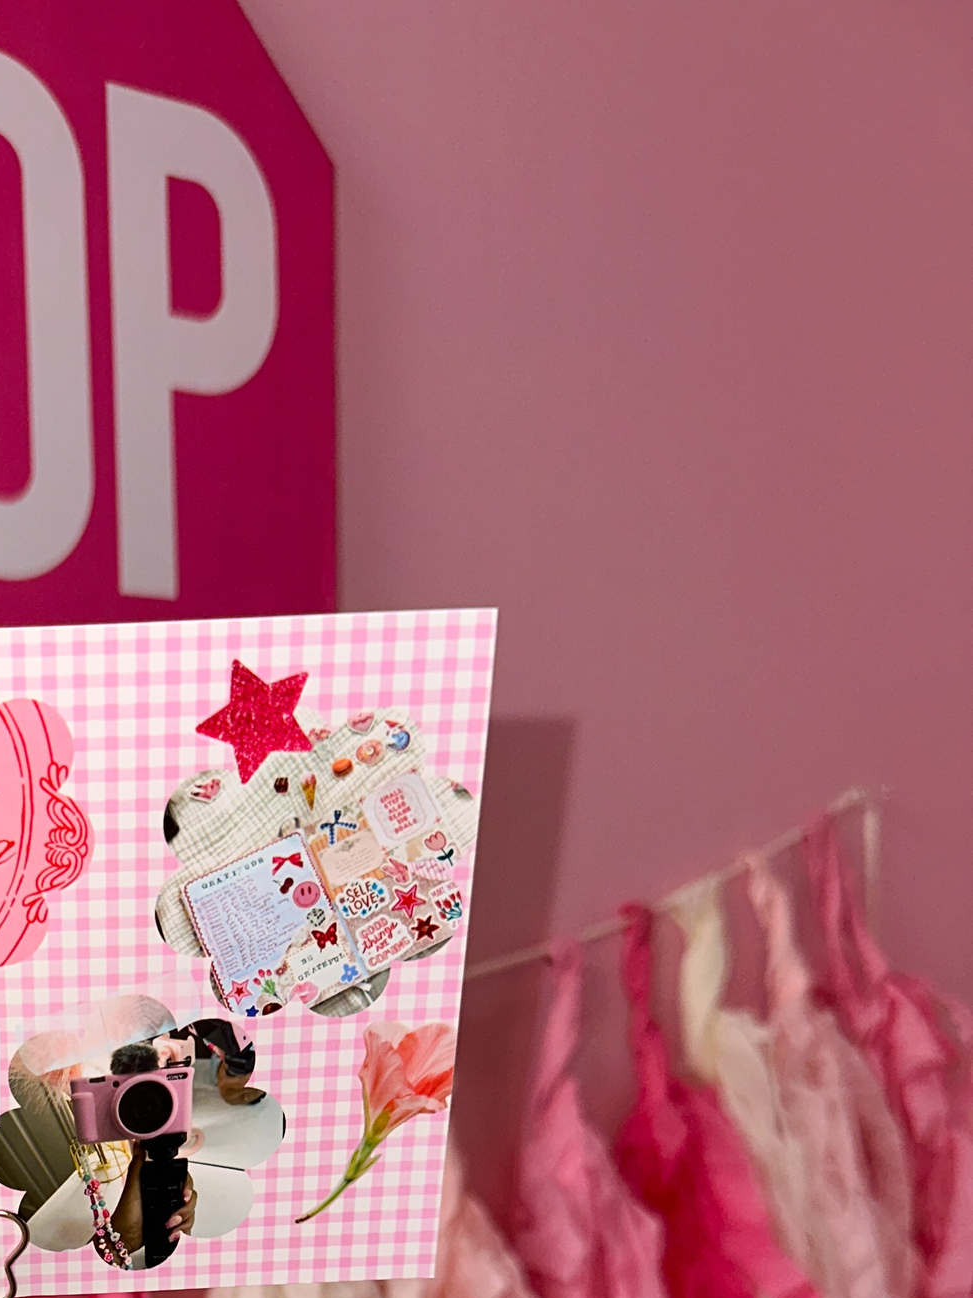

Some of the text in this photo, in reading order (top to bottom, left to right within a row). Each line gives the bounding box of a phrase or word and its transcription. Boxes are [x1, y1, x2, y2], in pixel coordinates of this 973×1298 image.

[345, 880, 371, 904] SELF
[347, 891, 378, 915] LOVE
[359, 917, 389, 939] GOOD
[361, 921, 399, 954] things
[300, 954, 314, 966] BE
[368, 936, 411, 967] COMING
[297, 952, 345, 982] GRATEFUL
